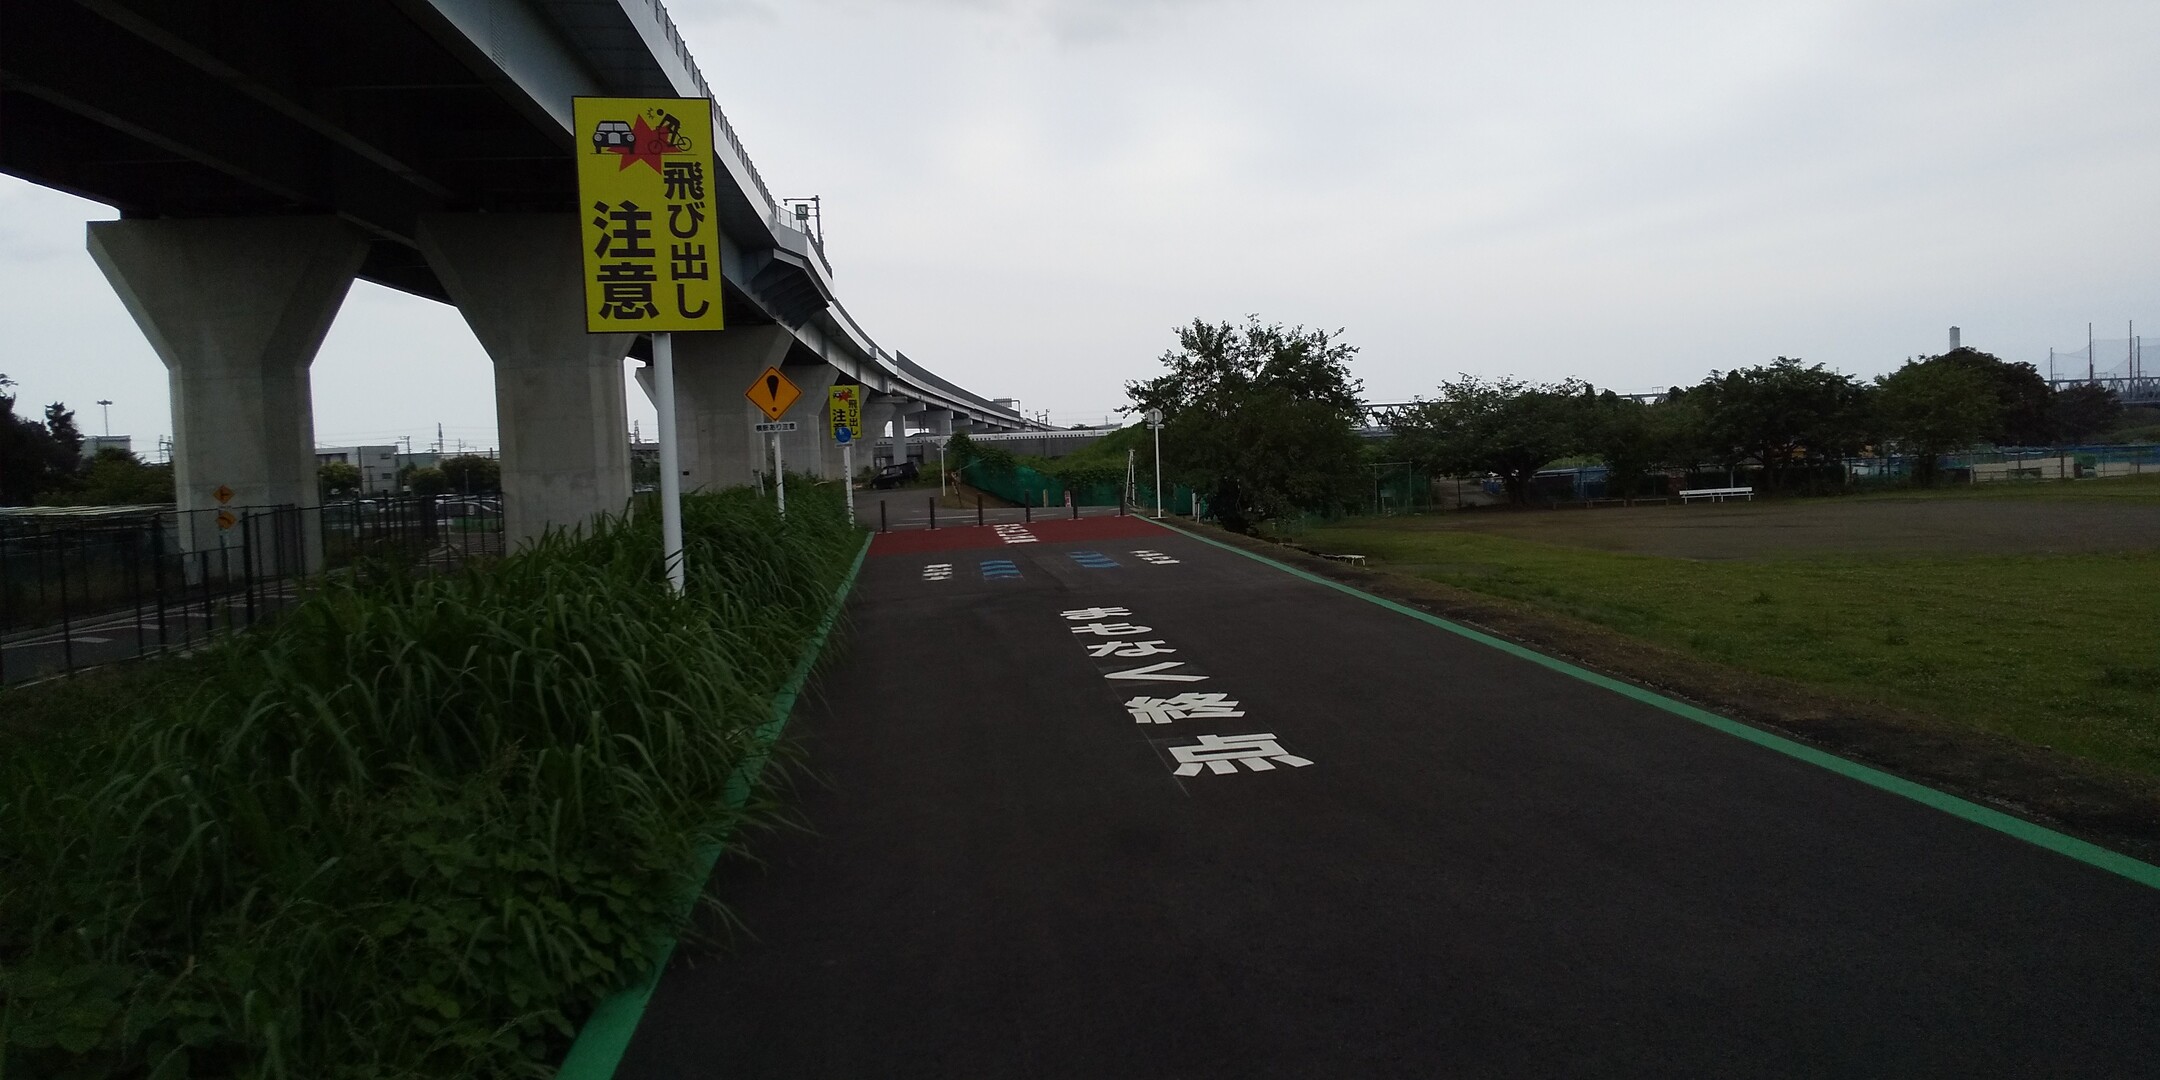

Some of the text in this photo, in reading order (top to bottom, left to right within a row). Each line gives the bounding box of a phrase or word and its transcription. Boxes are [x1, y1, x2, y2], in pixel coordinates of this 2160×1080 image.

[592, 200, 660, 320] 注意
[663, 161, 710, 319] 飛び出し
[848, 399, 859, 436] 飛び出し
[1060, 606, 1314, 777] まもなく終点
